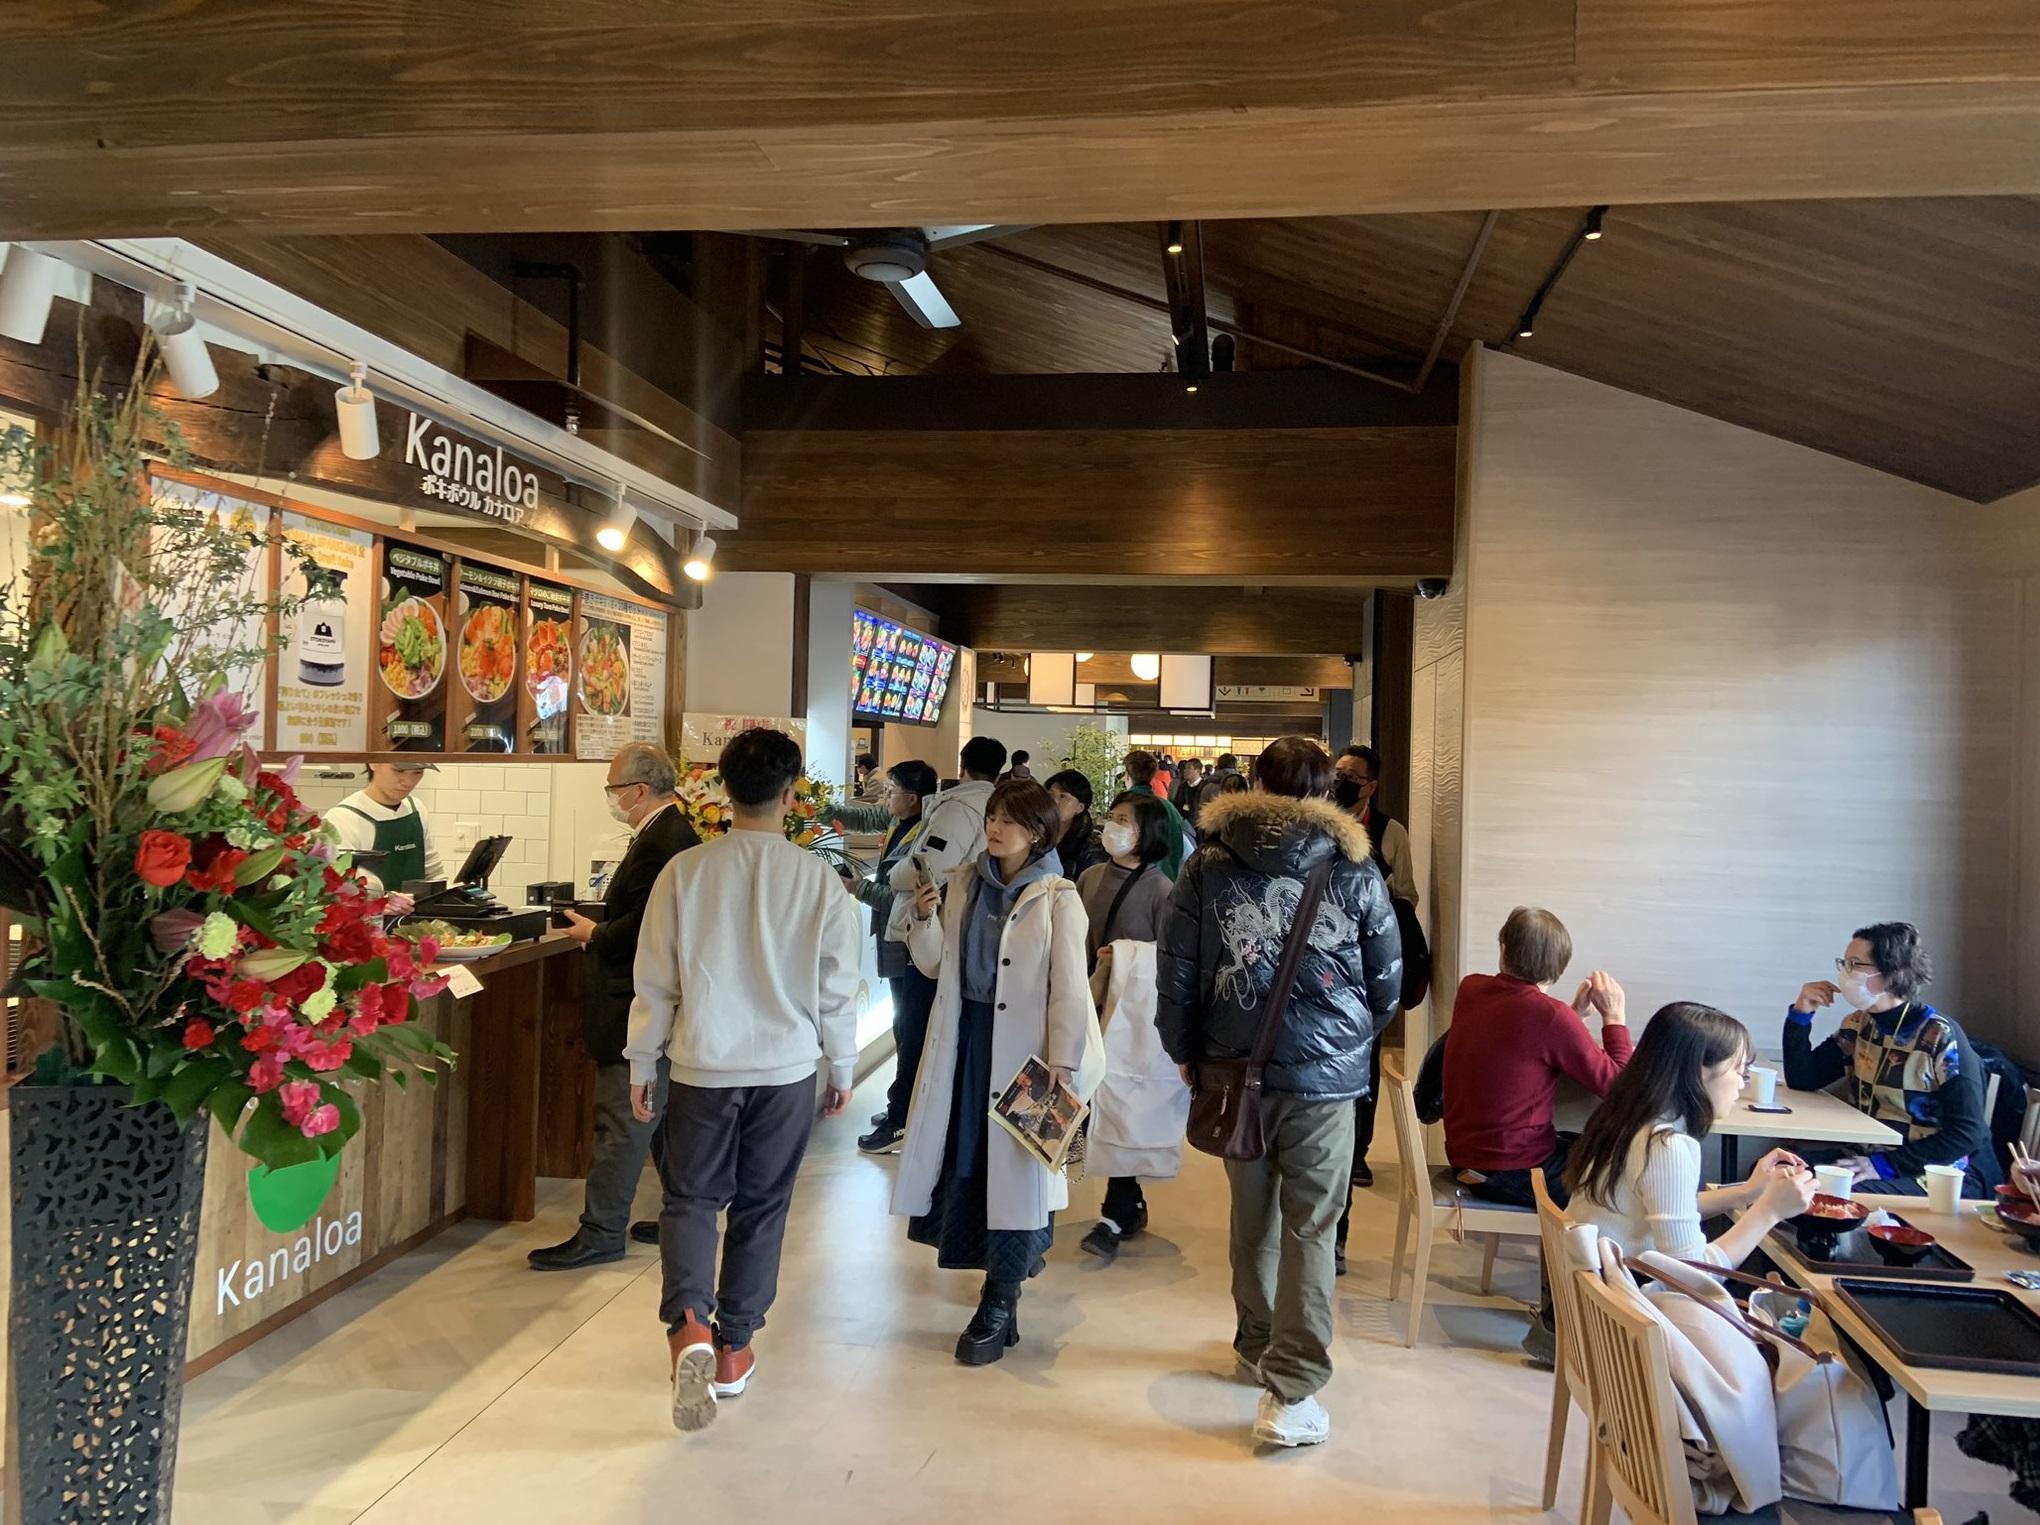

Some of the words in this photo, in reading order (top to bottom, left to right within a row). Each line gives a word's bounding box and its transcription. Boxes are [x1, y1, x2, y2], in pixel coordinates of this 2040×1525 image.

[405, 412, 539, 510] Kanaloa
[420, 474, 482, 510] ポキボウル
[483, 495, 525, 524] カナロア
[217, 1210, 362, 1315] Kanaloa
